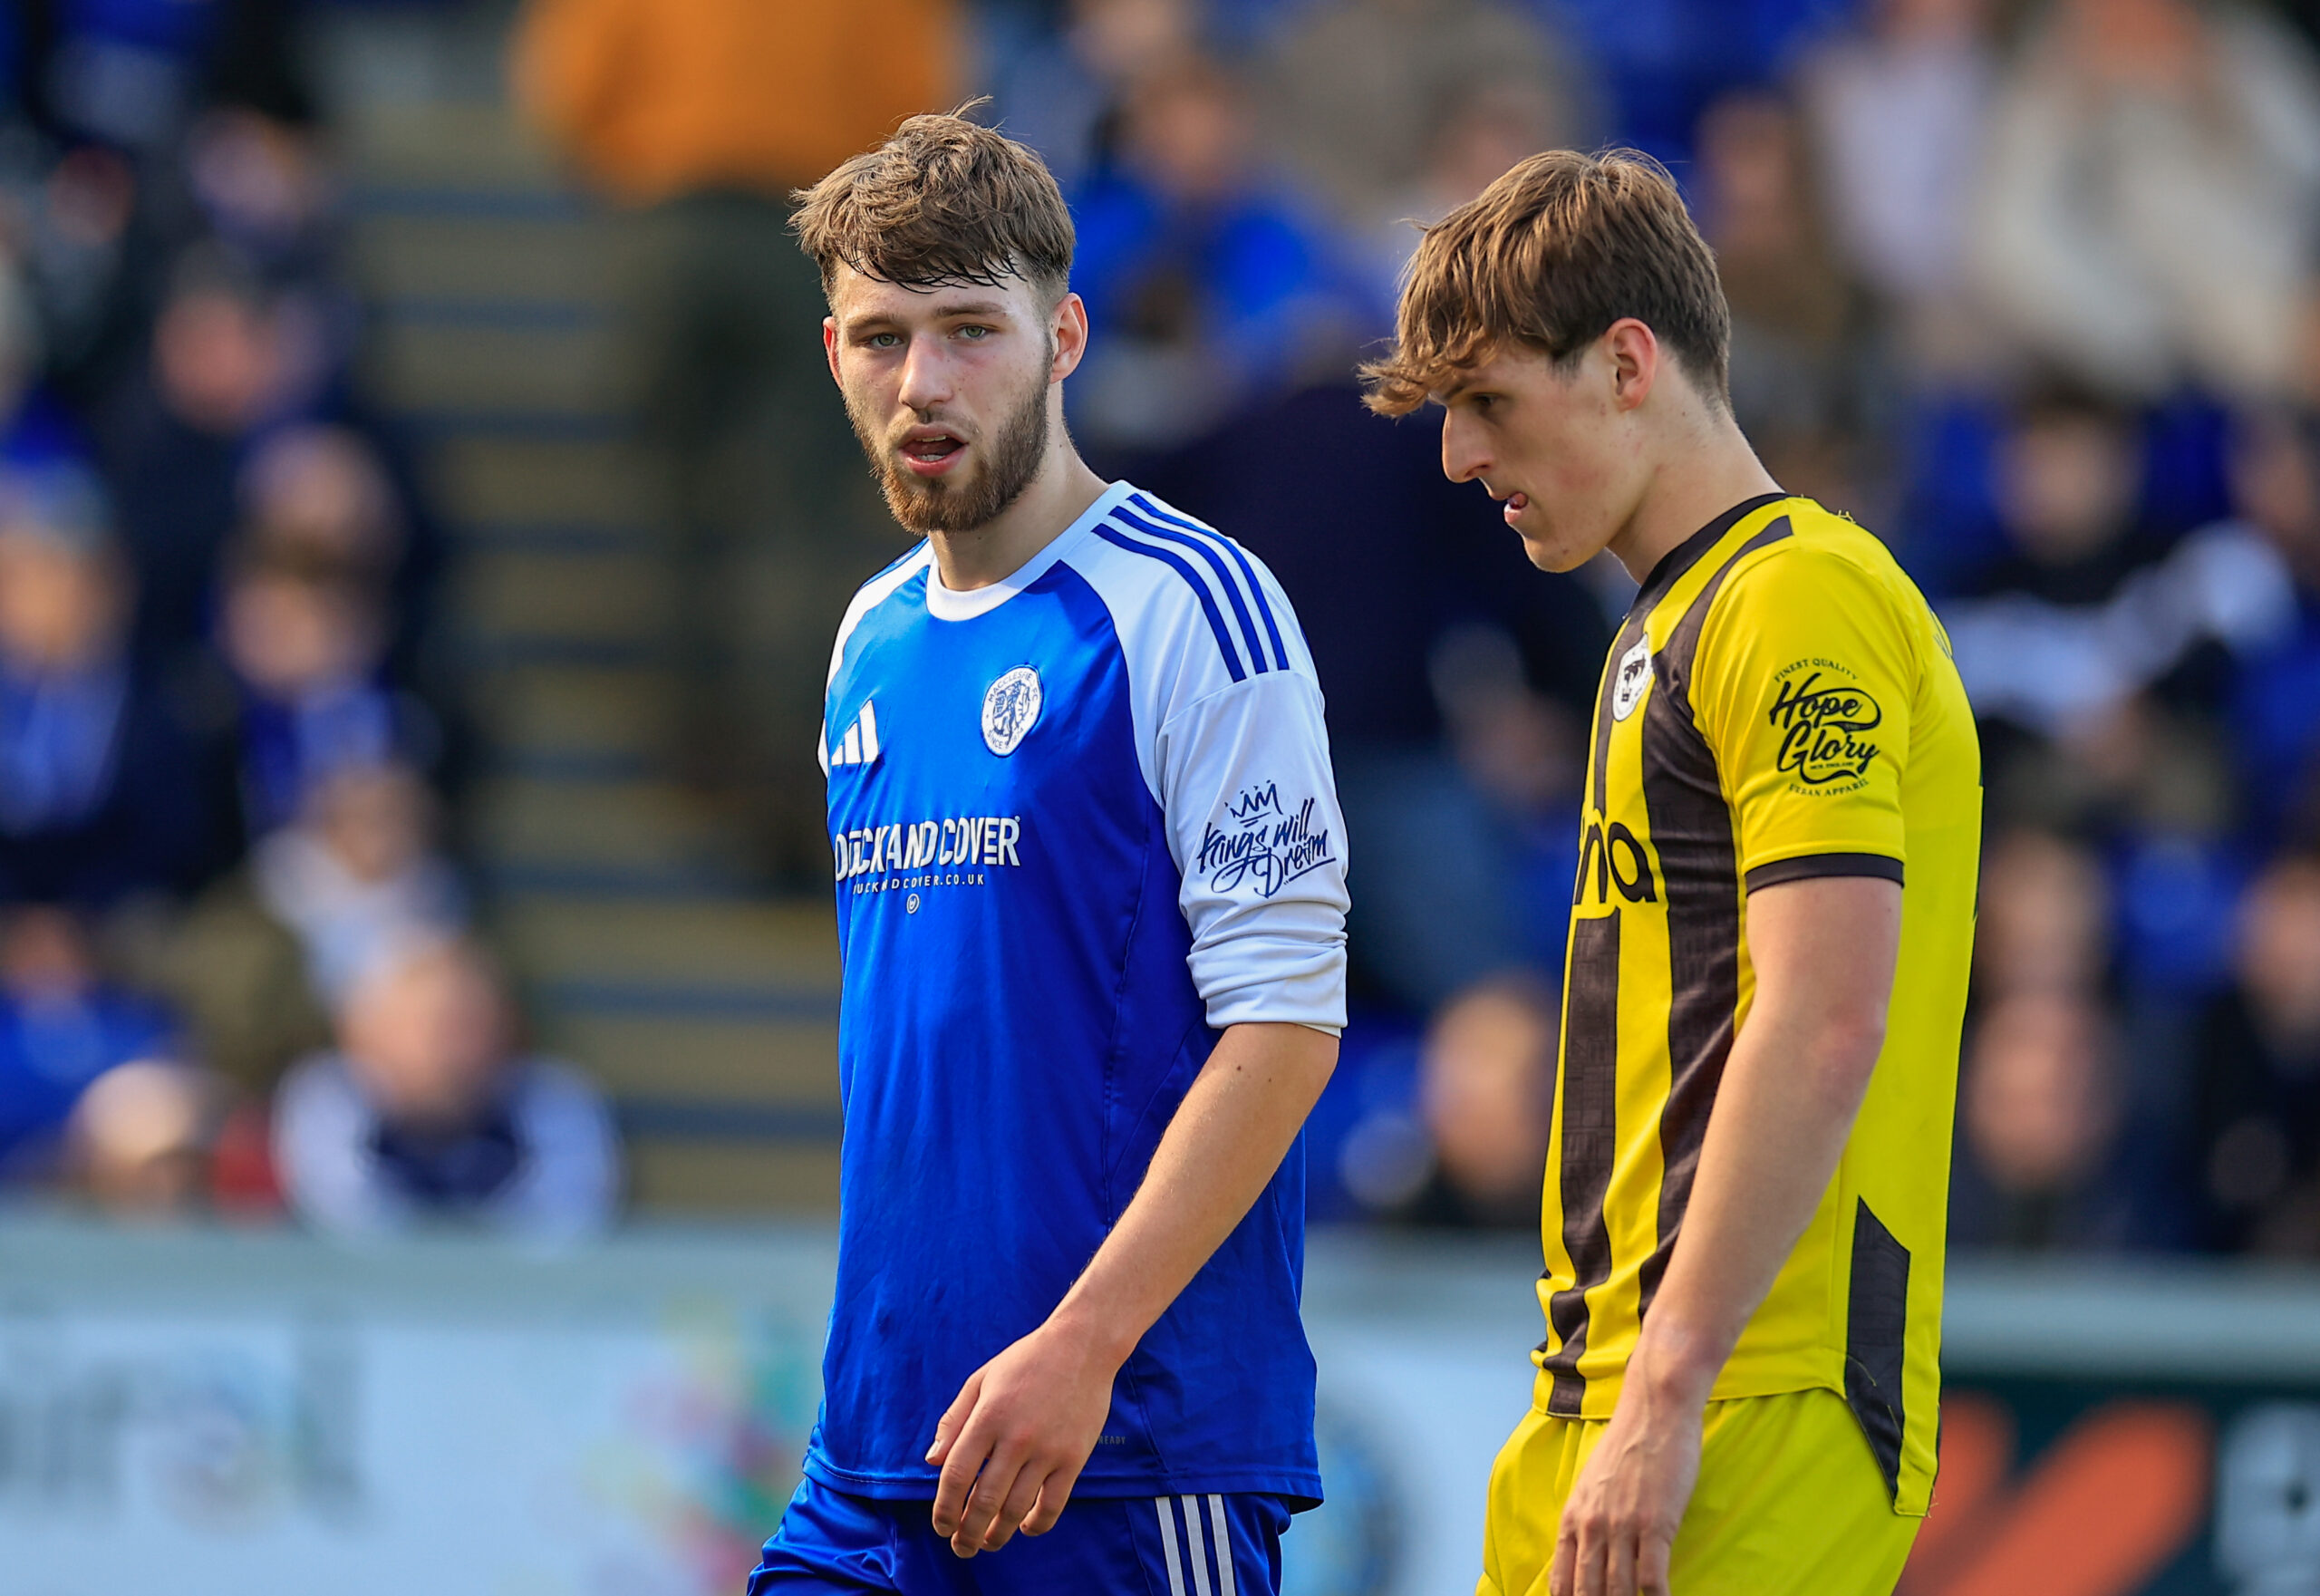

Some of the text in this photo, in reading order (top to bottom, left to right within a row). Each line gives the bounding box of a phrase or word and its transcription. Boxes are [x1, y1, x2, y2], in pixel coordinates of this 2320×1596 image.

[988, 672, 1036, 702] MACCLESFIE
[1774, 658, 1858, 682] FINEST QUALITY
[1769, 672, 1881, 732] Hope
[1777, 720, 1880, 785] Glory
